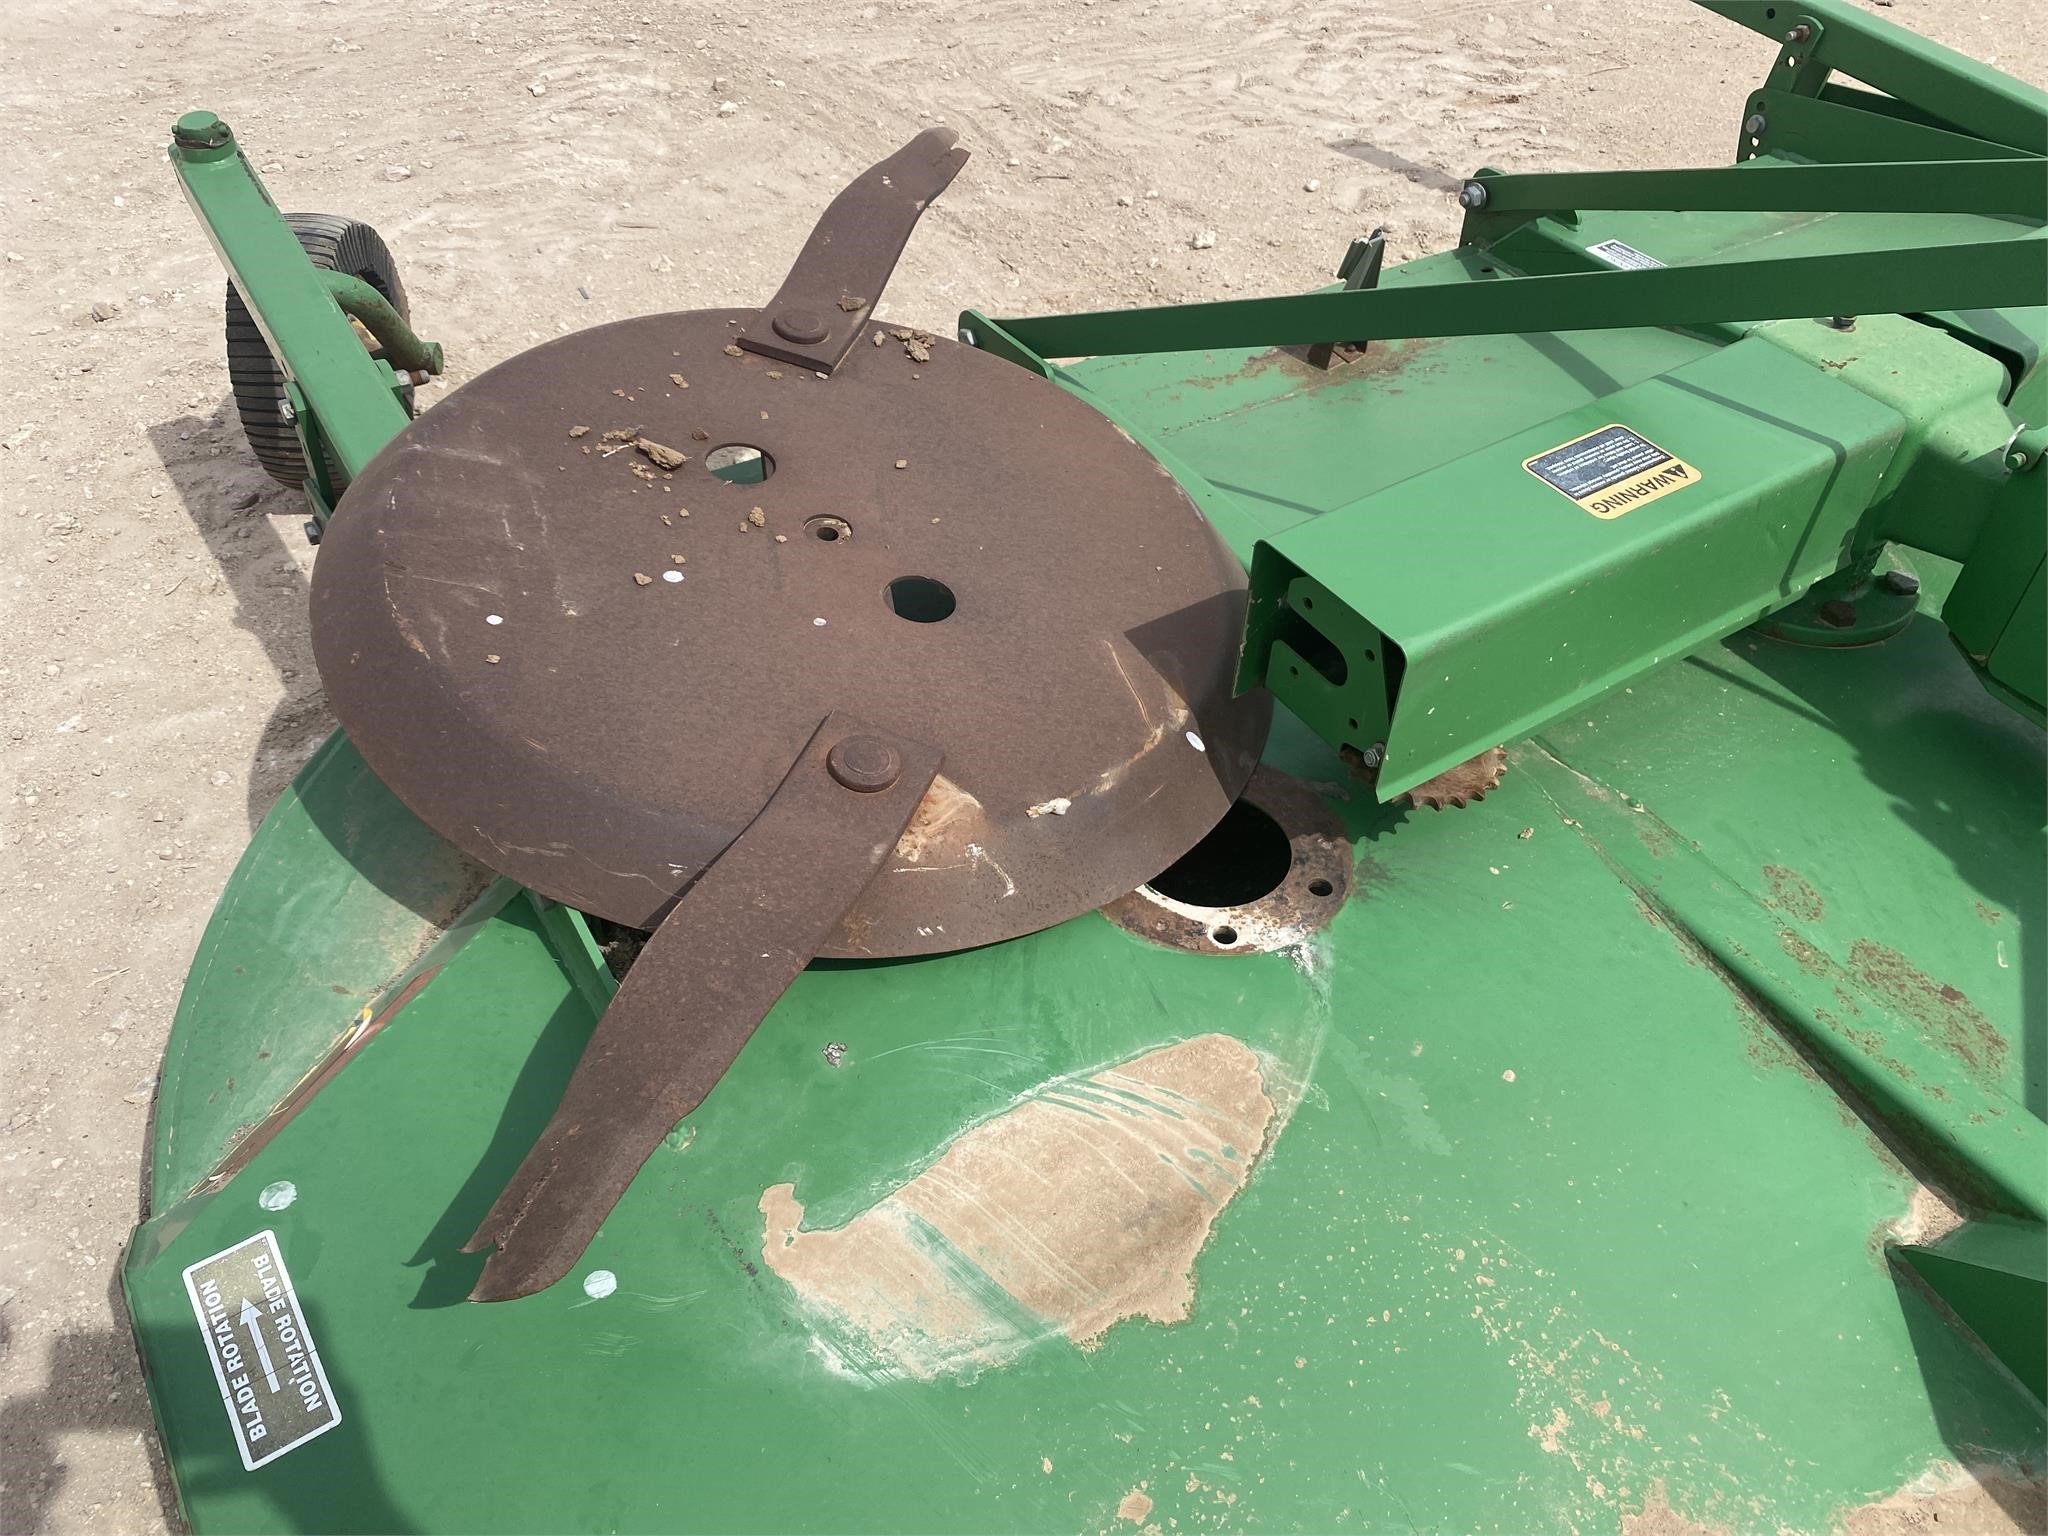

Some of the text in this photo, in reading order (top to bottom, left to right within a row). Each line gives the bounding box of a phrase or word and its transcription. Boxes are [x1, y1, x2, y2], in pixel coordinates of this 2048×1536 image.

[1591, 474, 1676, 514] WARNING
[200, 1278, 268, 1442] BLADE ROTATION
[253, 1253, 323, 1413] BLADE ROTATION
